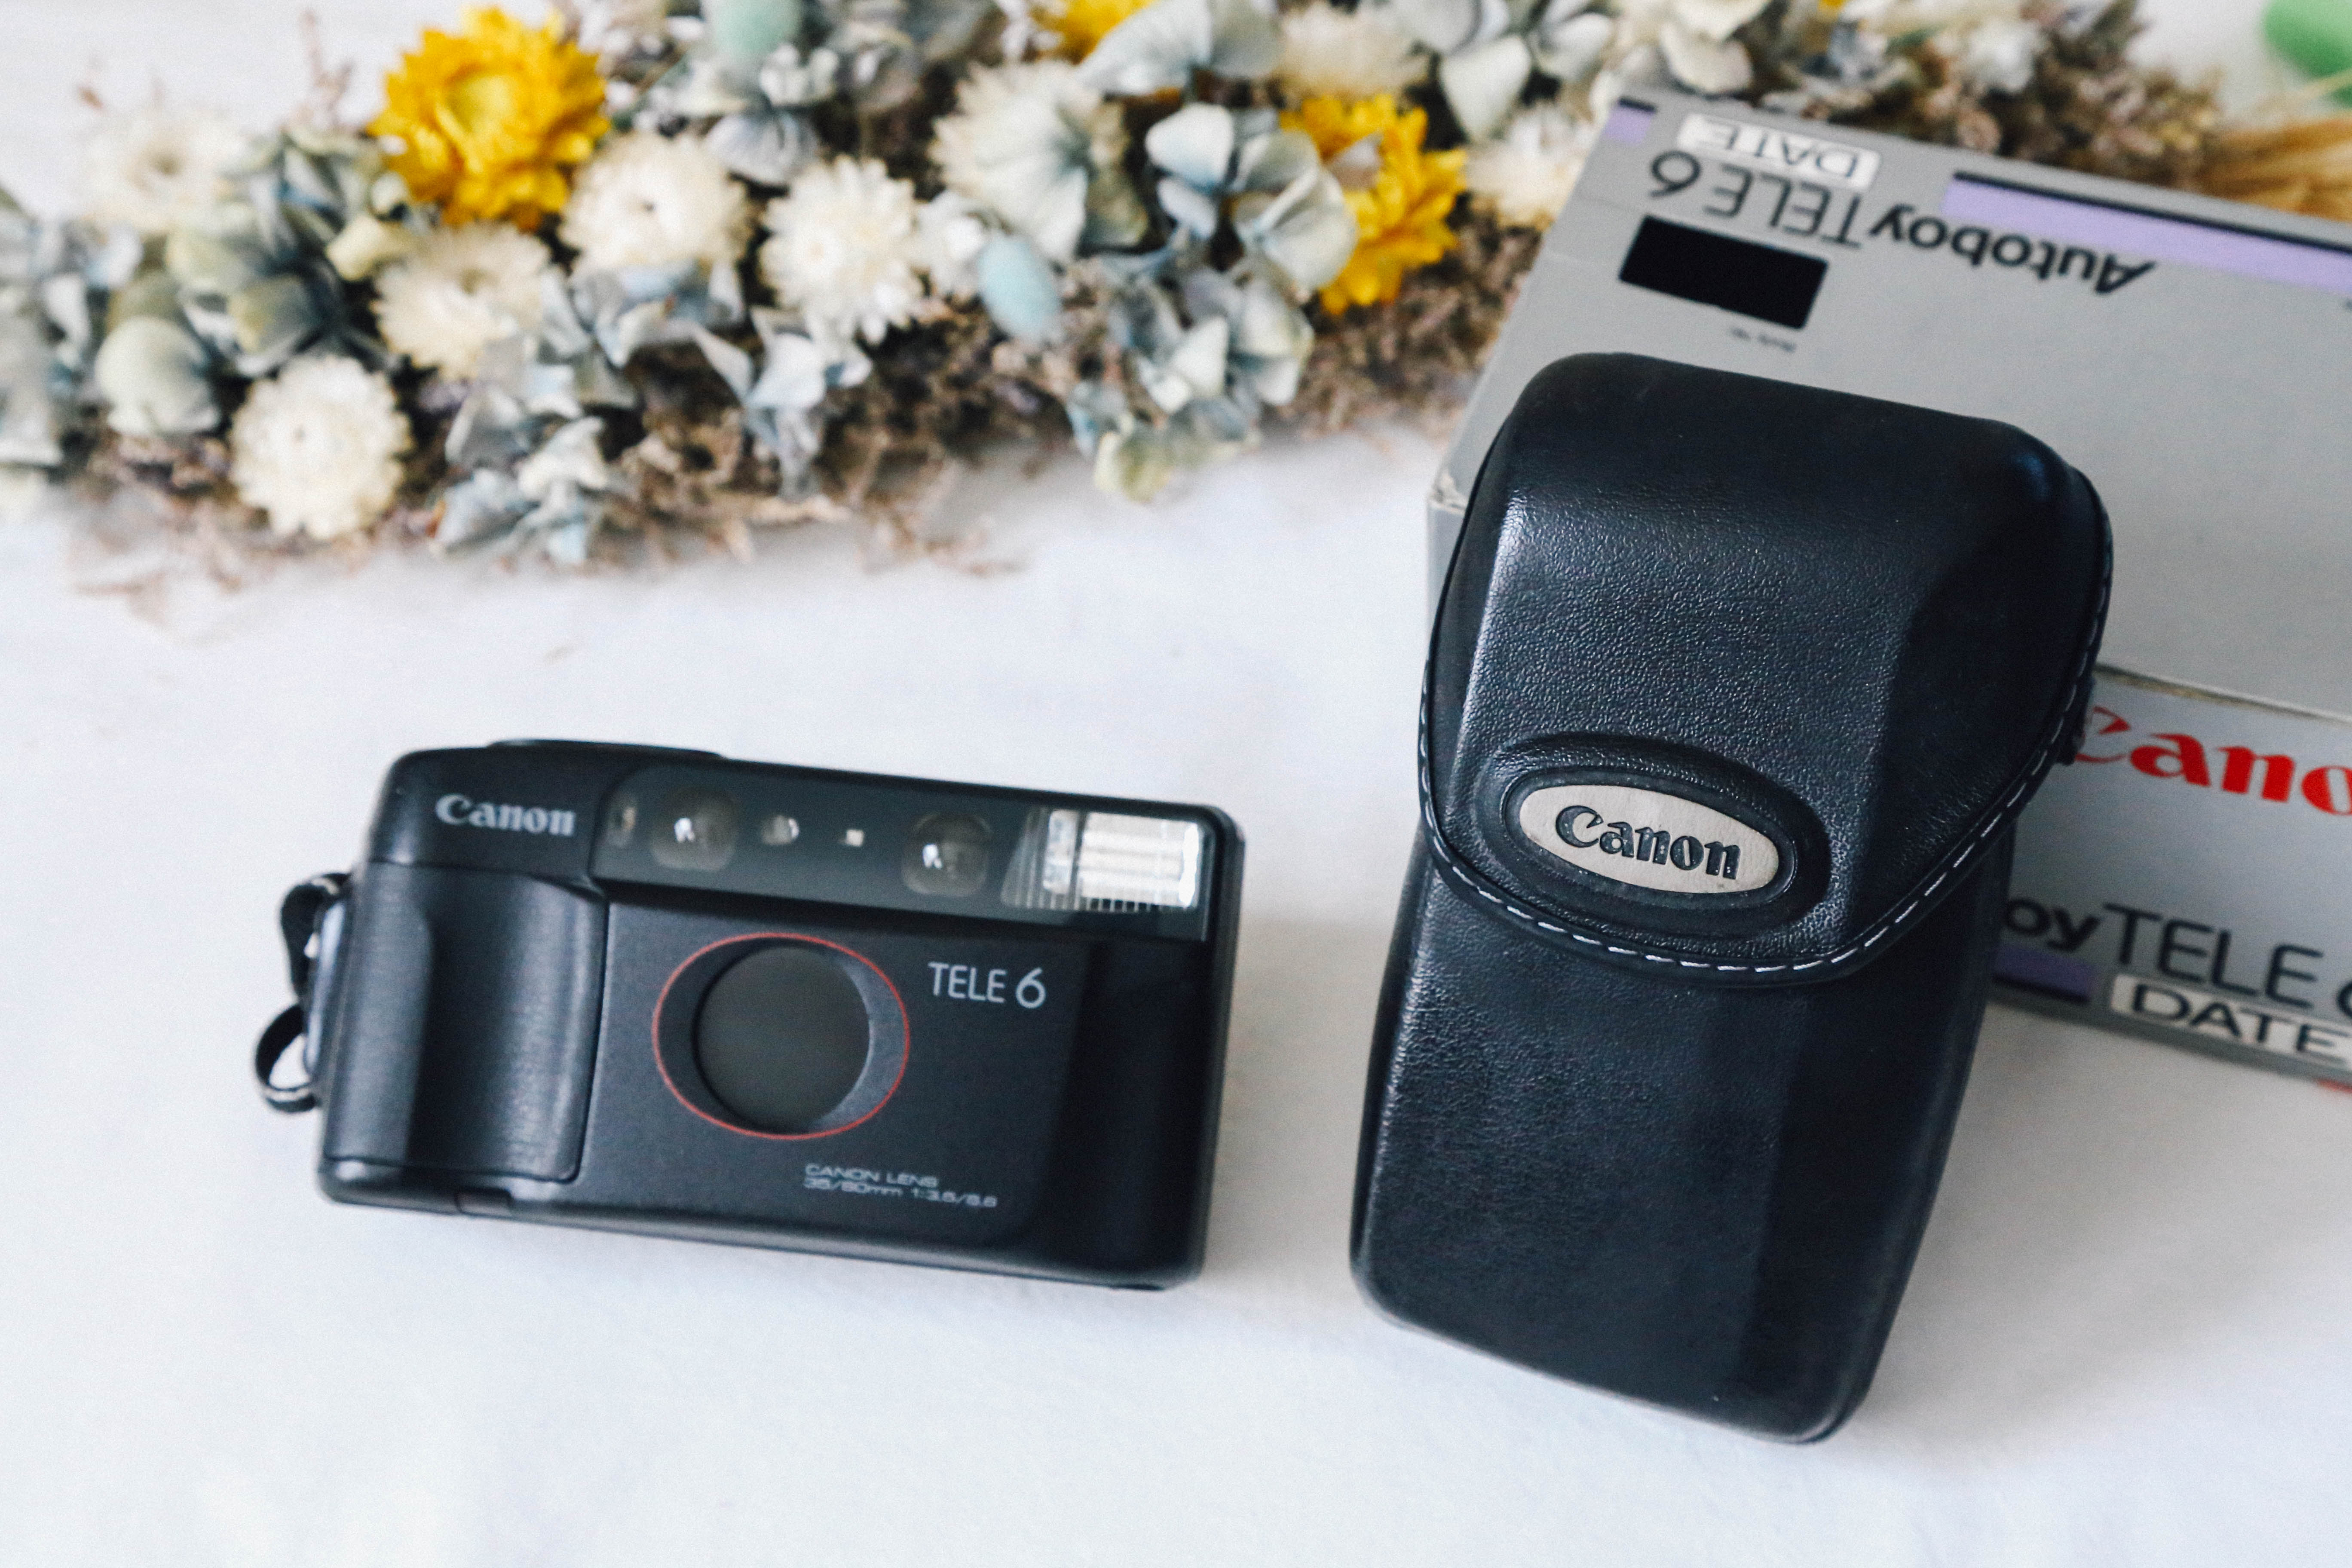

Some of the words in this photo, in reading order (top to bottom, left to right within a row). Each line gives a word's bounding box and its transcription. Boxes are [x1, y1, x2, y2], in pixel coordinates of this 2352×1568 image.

[1651, 150, 1702, 198] 6
[1696, 118, 1858, 177] DATE
[1703, 162, 1861, 248] TELE
[1869, 202, 2156, 295] Autoboy
[435, 793, 575, 836] Canon
[1555, 805, 1741, 879] Canon
[928, 962, 1007, 1003] TELE
[1016, 968, 1046, 1008] 6
[2104, 903, 2324, 1009] TELE
[2132, 983, 2352, 1064] DATE
[805, 1164, 880, 1182] CANON
[886, 1172, 938, 1188] LENS
